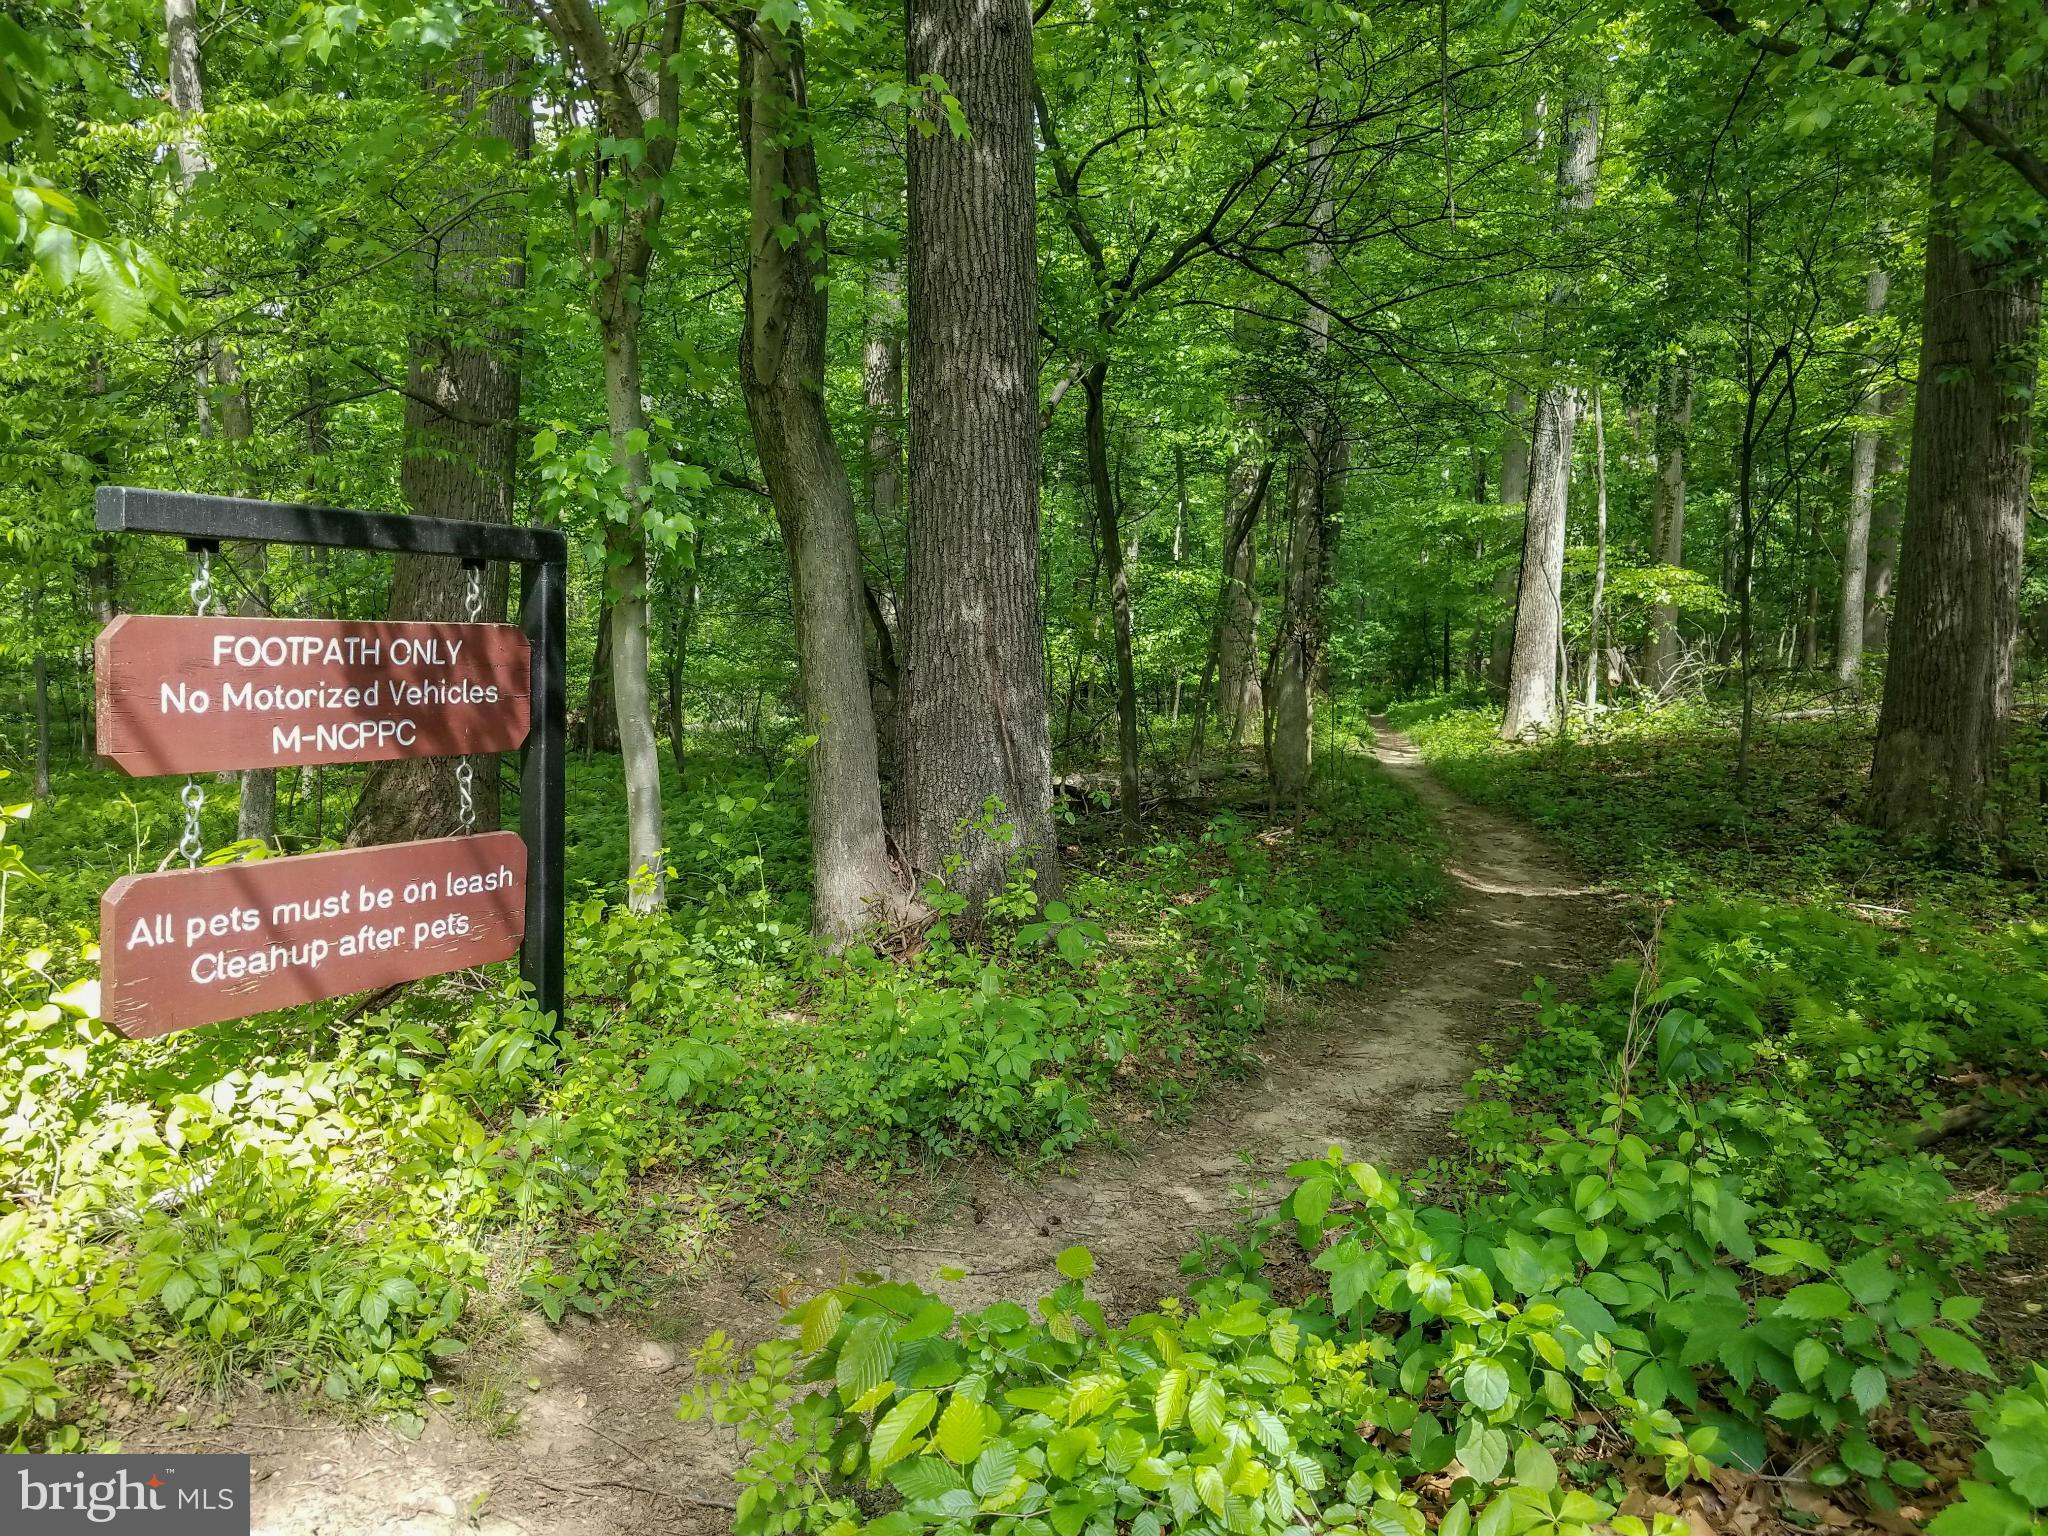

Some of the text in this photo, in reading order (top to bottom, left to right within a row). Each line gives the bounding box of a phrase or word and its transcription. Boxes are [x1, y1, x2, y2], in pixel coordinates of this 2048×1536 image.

[213, 635, 462, 667] FOOTPATH ONLY
[160, 680, 498, 714] No Motorized Vehicles
[272, 719, 417, 754] M-NCPPC
[126, 865, 513, 951] All pets must be on leash
[338, 924, 405, 958] after
[413, 913, 469, 949] pets
